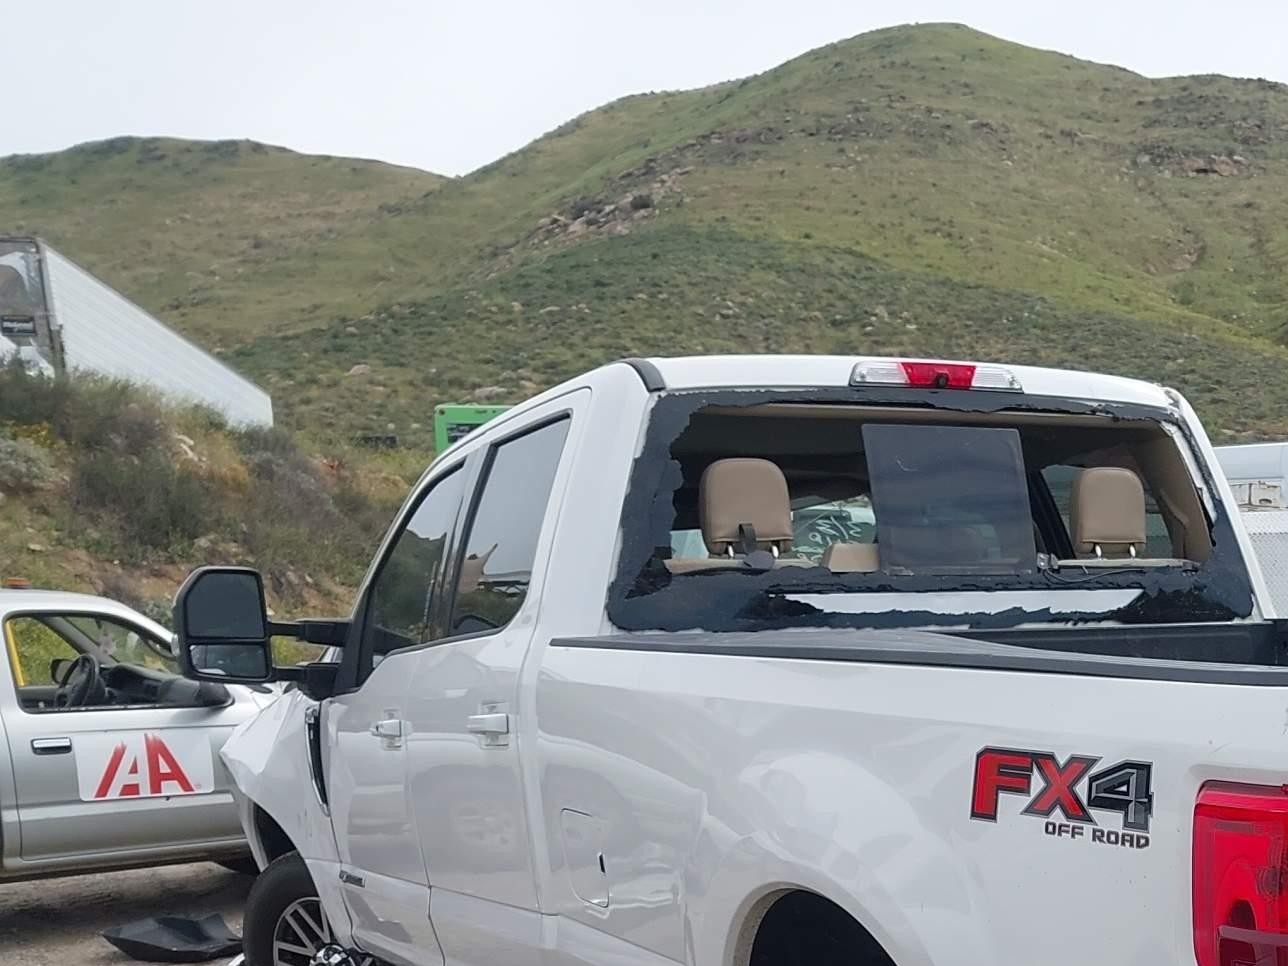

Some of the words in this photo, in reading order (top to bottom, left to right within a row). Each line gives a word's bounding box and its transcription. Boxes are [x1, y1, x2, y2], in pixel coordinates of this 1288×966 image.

[970, 745, 1154, 833] FX4
[1044, 821, 1084, 840] OFF
[1092, 828, 1150, 849] ROAD
